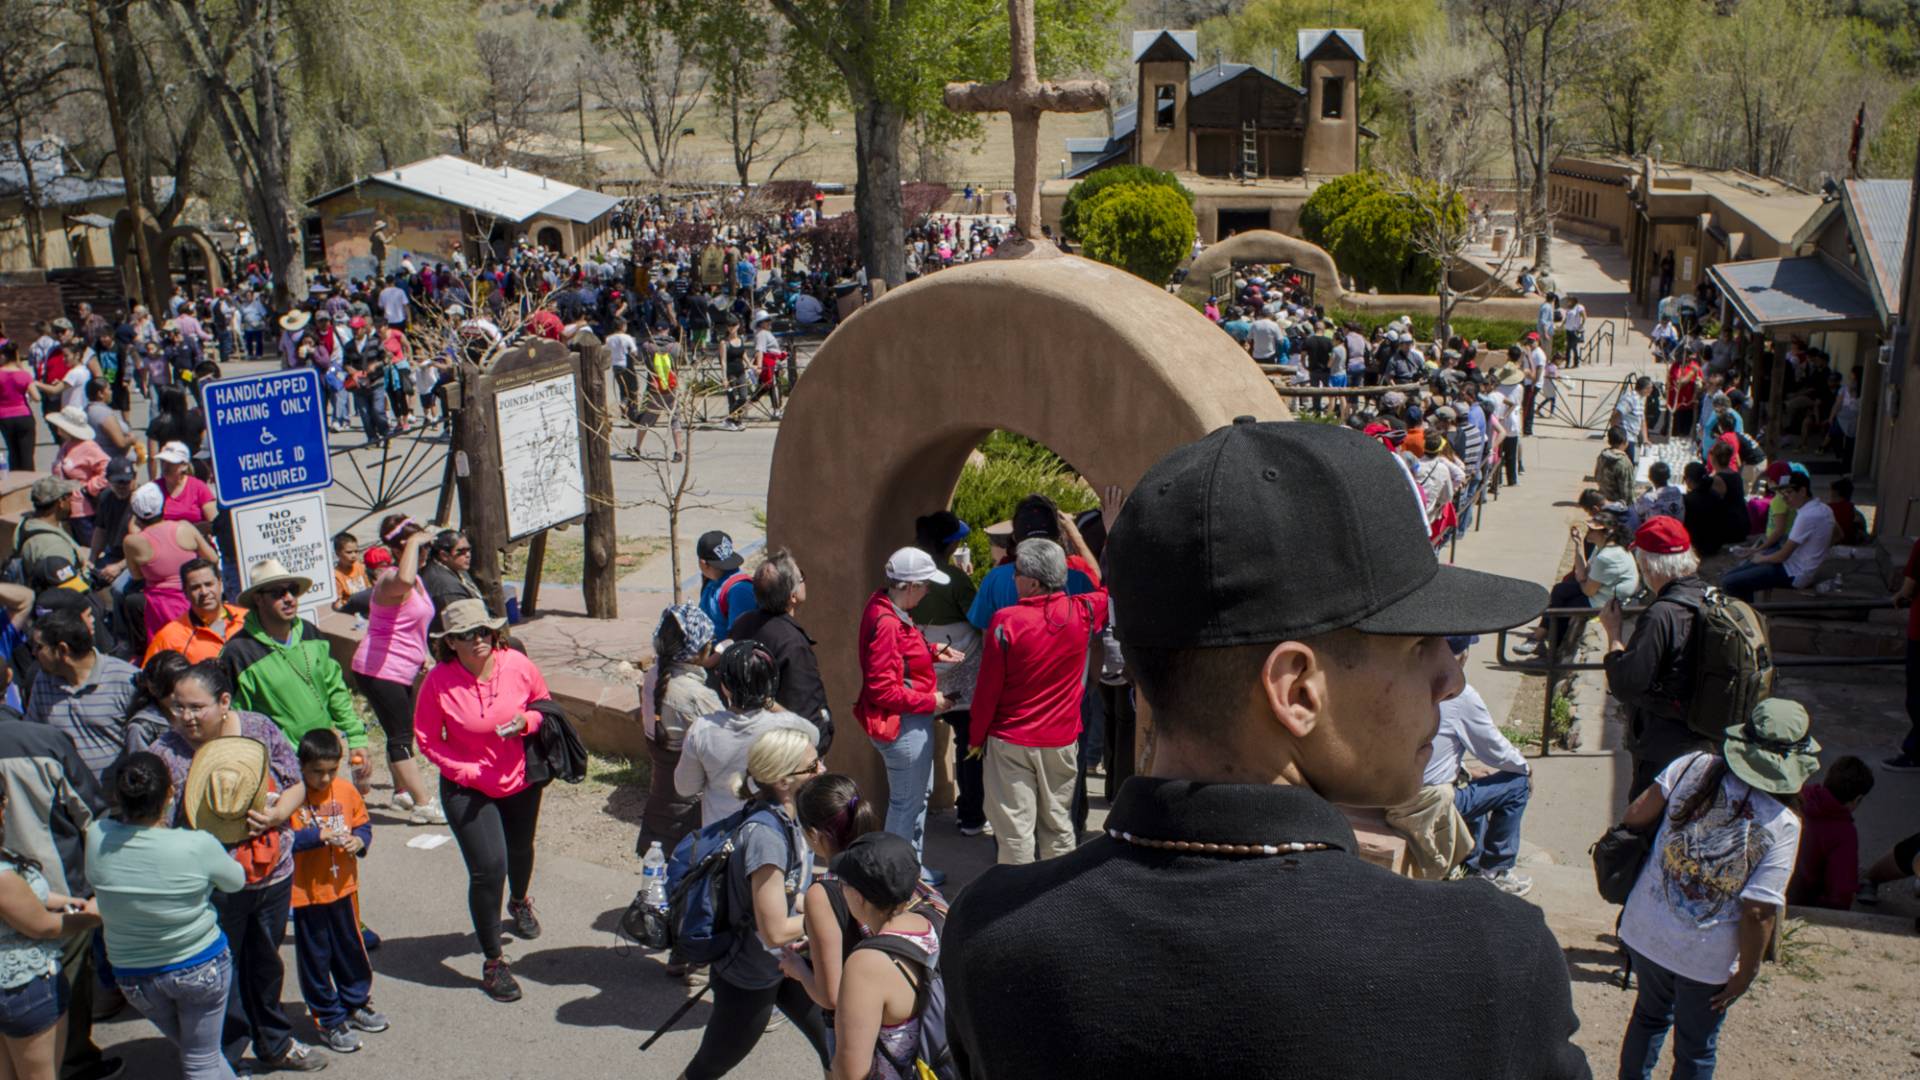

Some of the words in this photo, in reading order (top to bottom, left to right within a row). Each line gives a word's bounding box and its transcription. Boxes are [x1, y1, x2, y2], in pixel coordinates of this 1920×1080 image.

[215, 376, 308, 405] HANDICAPPED
[216, 402, 270, 426] PARKING
[281, 396, 312, 416] ONLY
[238, 449, 284, 472] VEHICLE
[293, 445, 305, 462] ID
[241, 466, 308, 493] REQUIRED
[269, 510, 291, 520] NO
[256, 516, 306, 531] TRUCKS
[262, 524, 303, 540] BUSES
[248, 551, 278, 562] OTHER
[280, 541, 322, 556] VEHICLES
[294, 551, 314, 559] FEET
[304, 554, 324, 564] THIS
[300, 562, 315, 572] LOT
